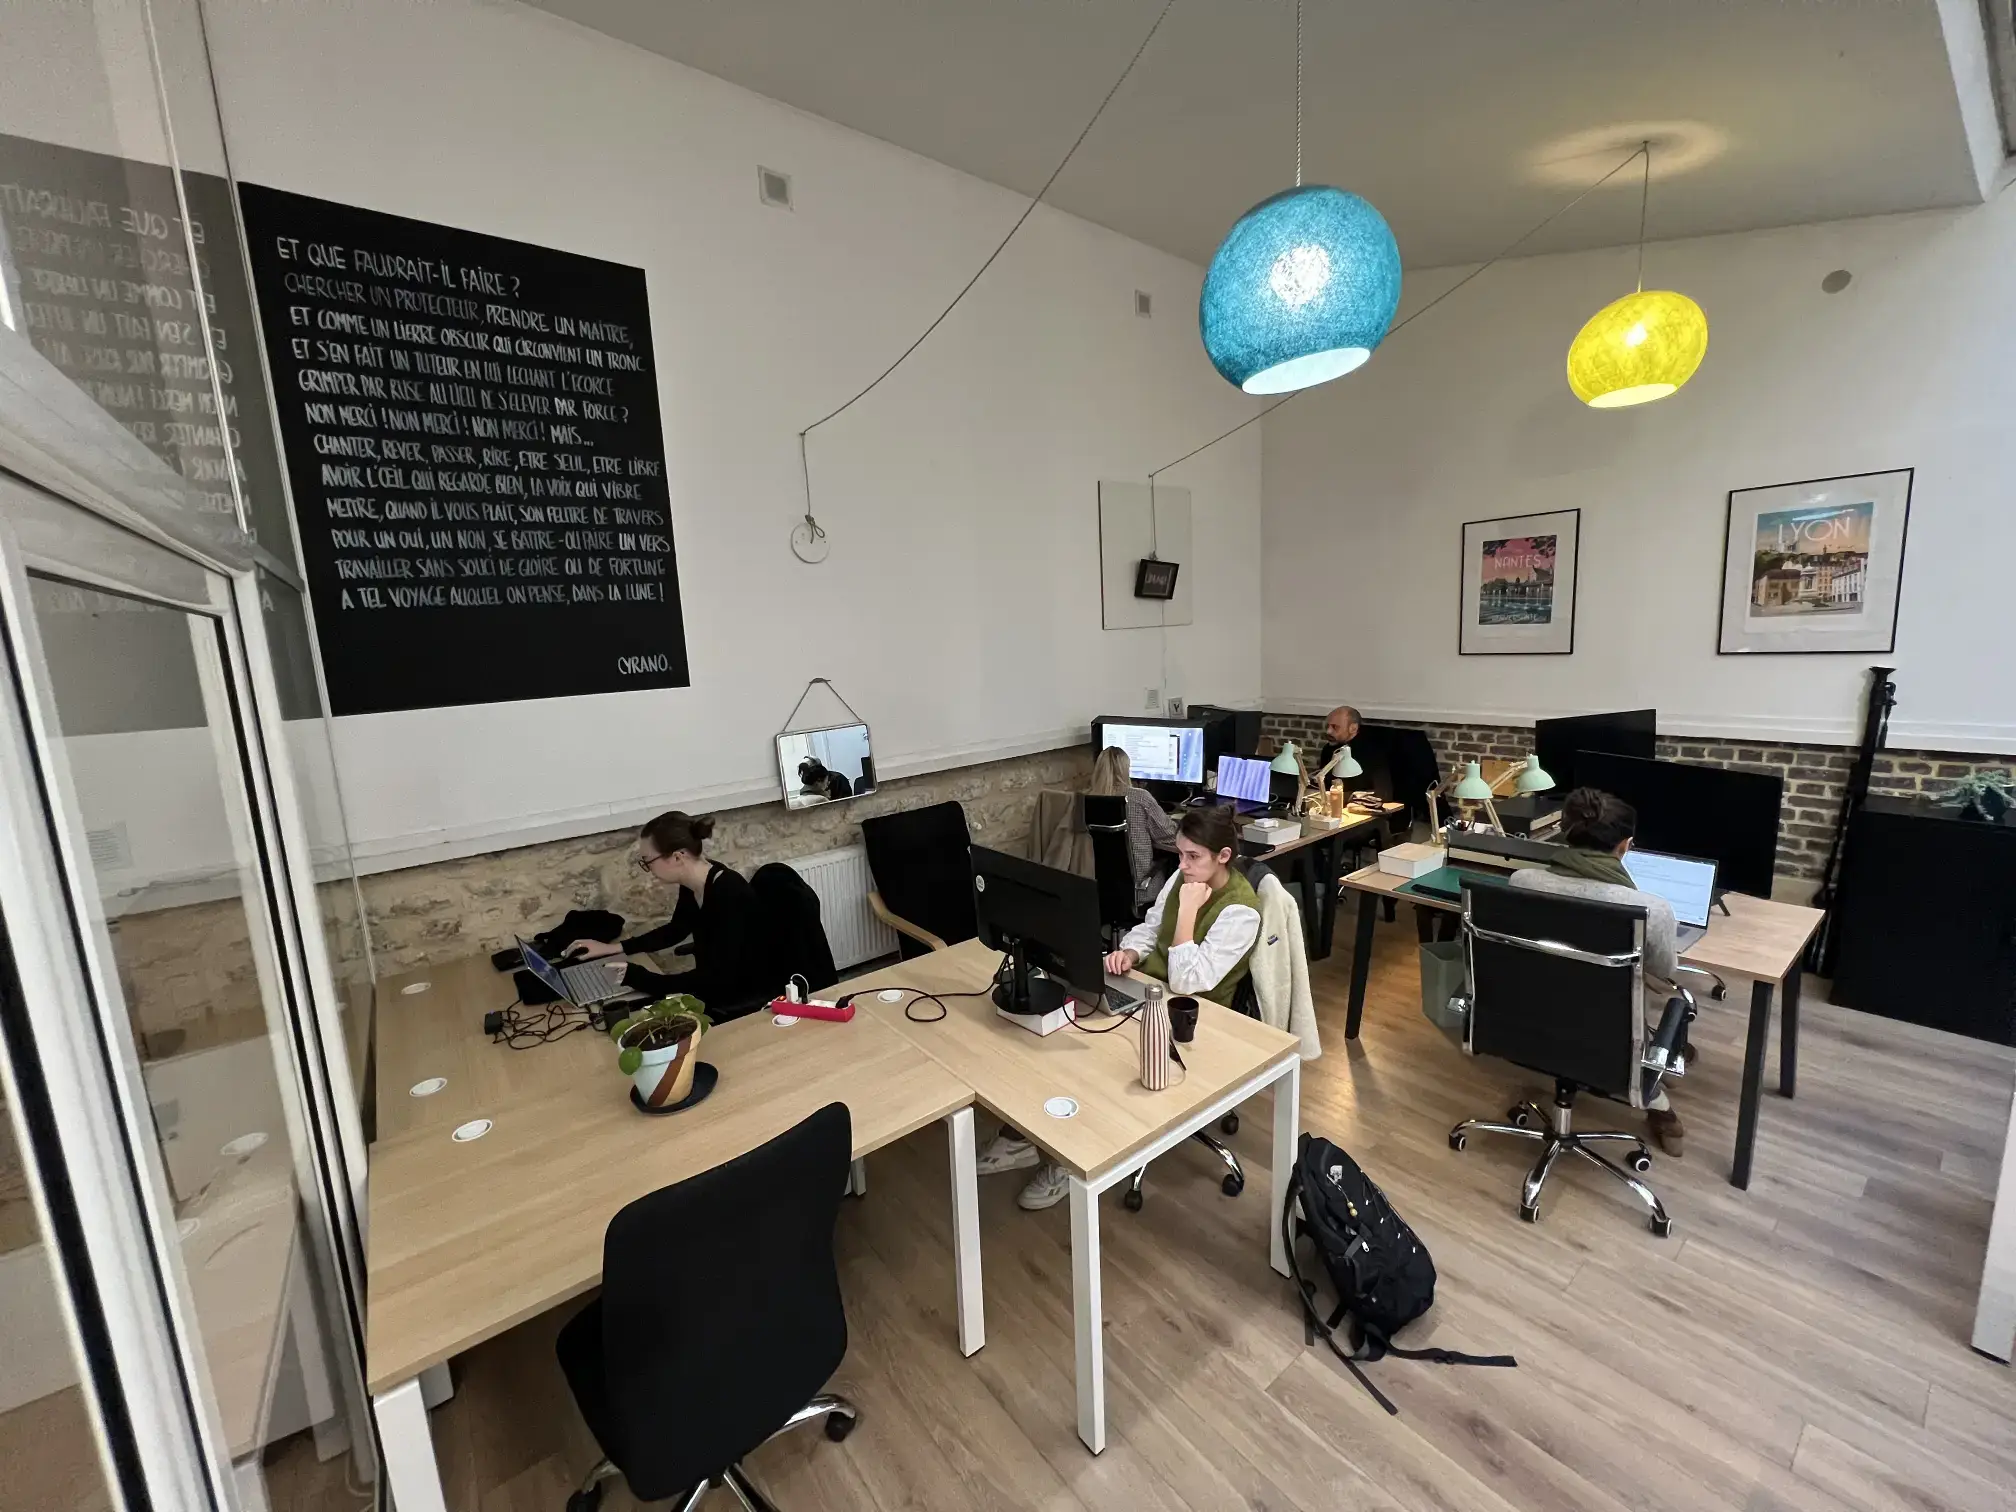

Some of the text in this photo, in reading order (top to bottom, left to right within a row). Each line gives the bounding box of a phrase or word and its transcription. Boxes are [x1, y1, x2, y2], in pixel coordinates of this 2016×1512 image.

[277, 236, 300, 260] ET
[308, 243, 347, 269] QUE
[460, 266, 507, 296] FAIRE
[284, 272, 366, 303] CHERCHER
[369, 286, 391, 308] UN
[486, 304, 550, 332] PRENDRE
[555, 315, 576, 336] UN
[290, 306, 311, 326] ET
[317, 308, 369, 335] COMME
[370, 317, 391, 339] UN
[393, 319, 438, 345] LIERRE
[440, 328, 490, 351] OBSCUR
[493, 335, 512, 355] QUI
[586, 348, 603, 368] UN
[606, 351, 647, 372] TRONC
[291, 338, 310, 359] ET
[316, 340, 350, 364] S'EN
[353, 342, 384, 368] FAIT
[390, 349, 410, 372] UN
[412, 351, 463, 378] TUTEUR
[464, 360, 482, 381] EN
[484, 361, 503, 384] LUI
[507, 364, 555, 390] LECHANT
[298, 369, 361, 396] GRIMPER
[360, 374, 388, 400] PAR
[389, 379, 426, 402] RUSE
[429, 382, 448, 405] AU
[481, 389, 497, 410] DE
[554, 397, 578, 417] PAR
[582, 400, 618, 422] FORCE
[304, 402, 337, 425] NON
[339, 403, 378, 428] MERCI
[389, 408, 421, 432] NON
[422, 410, 461, 436] MERCI
[471, 416, 500, 439] NON
[519, 450, 549, 471] ETRE
[592, 456, 624, 475] ETRE
[628, 457, 661, 477] LIBRE
[321, 462, 365, 488] AVOIR
[411, 466, 436, 491] QUI
[437, 470, 493, 494] REGARDE
[530, 477, 545, 497] LA
[547, 475, 572, 497] VOIX
[575, 478, 599, 499] QUI
[601, 480, 643, 500] VIBRE
[385, 500, 428, 520] QUAND
[444, 501, 480, 522] VOUS
[519, 504, 545, 523] SON
[547, 505, 589, 525] FEUTRE
[593, 507, 608, 525] DE
[612, 507, 664, 526] TRAVERS
[330, 528, 372, 549] POUR
[373, 530, 397, 549] UN
[430, 530, 453, 549] UN
[493, 530, 509, 550] SE
[582, 527, 614, 551] FAIRE
[618, 533, 636, 551] UN
[639, 533, 671, 553] VERS
[1778, 516, 1851, 544] LYON
[334, 554, 666, 580] TRAVAILLER SANS SOUCI DE GLOIRE OU DE FORTUNE
[1494, 554, 1542, 570] NANTES
[341, 588, 355, 610] A
[357, 587, 387, 609] TEL
[388, 585, 446, 609] VOYAGE
[450, 586, 503, 607] AUQUEL
[506, 584, 527, 604] ON
[572, 583, 604, 603] DANS
[608, 583, 622, 601] LA
[625, 583, 655, 601] LUNE
